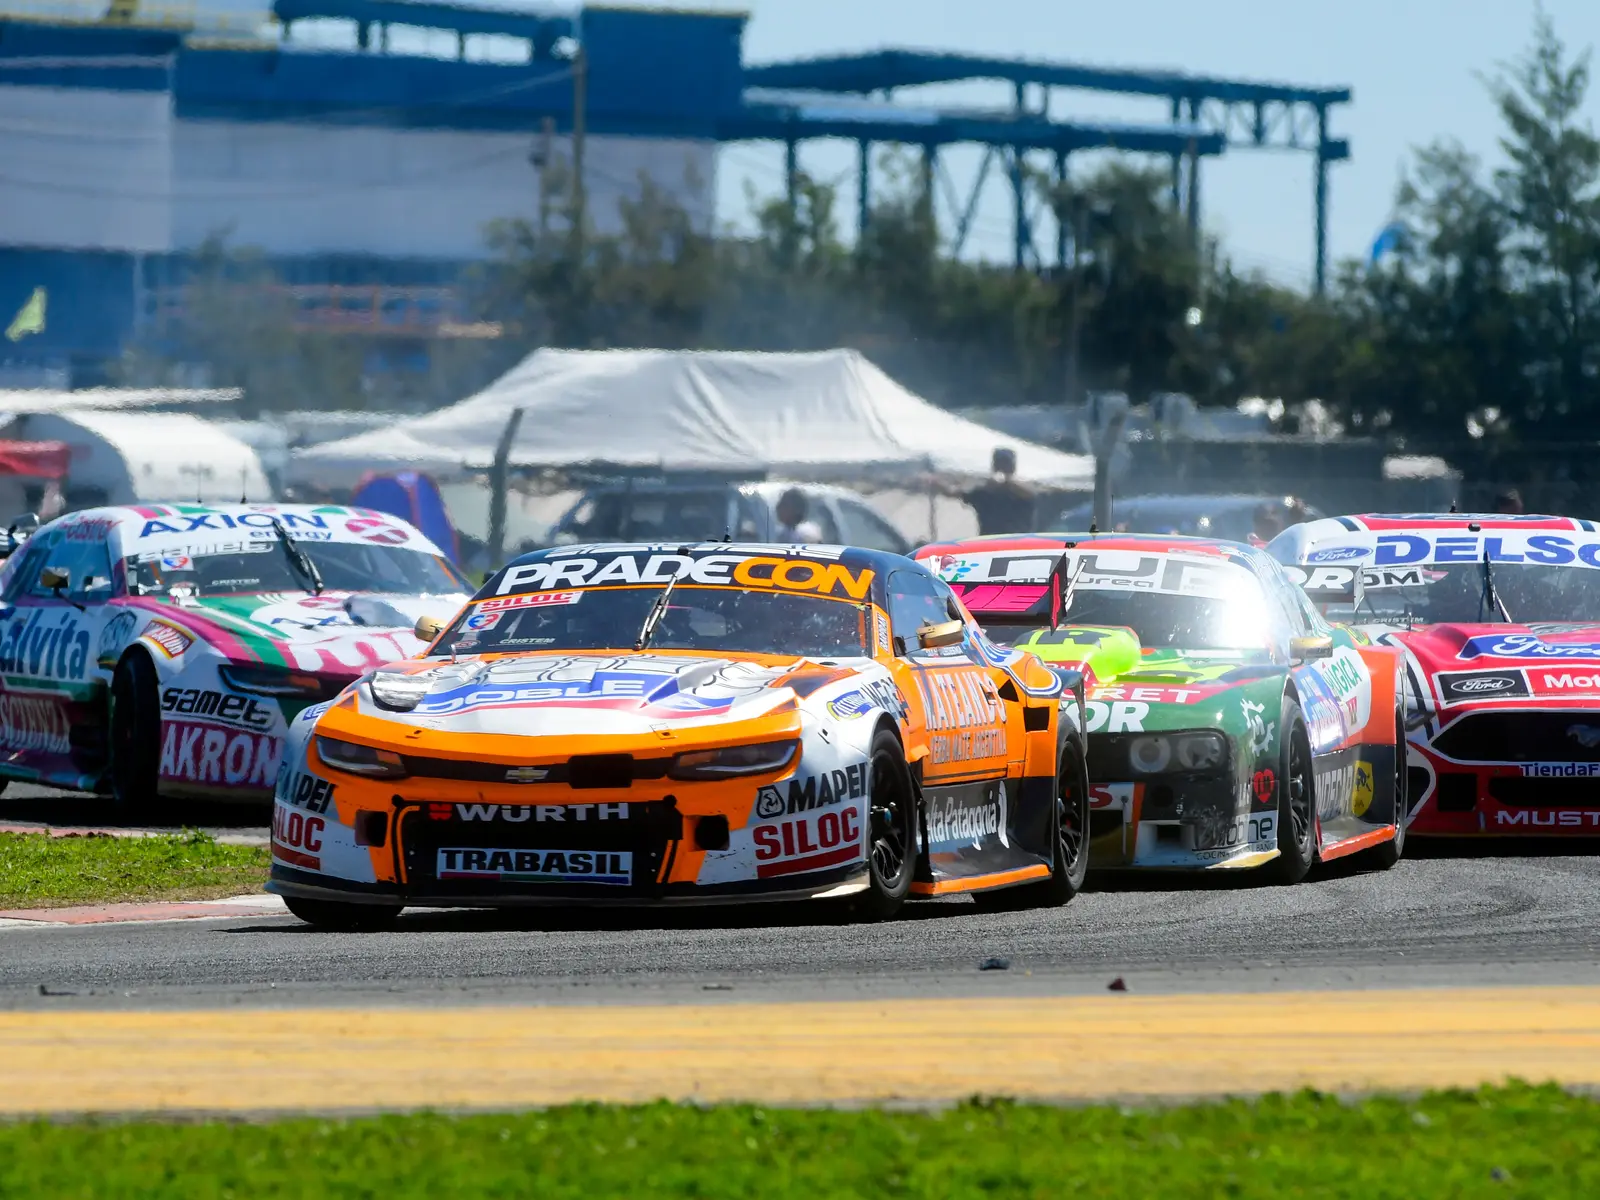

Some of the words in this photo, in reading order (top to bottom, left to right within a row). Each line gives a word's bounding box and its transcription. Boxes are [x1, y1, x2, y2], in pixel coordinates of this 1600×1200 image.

[139, 514, 329, 538] AXION
[249, 530, 332, 542] energy
[496, 554, 876, 599] PRADECON
[480, 592, 573, 610] SILOC
[0, 607, 90, 680] alvita
[161, 687, 272, 725] samet
[414, 681, 645, 712] DOBLE
[1060, 701, 1150, 732] OR
[159, 723, 285, 788] AKRON
[787, 762, 868, 814] MAPEI
[272, 801, 325, 852] SILOC
[455, 803, 630, 822] WÜRTH
[753, 806, 860, 860] SILOC
[440, 850, 630, 874] TRABASIL
